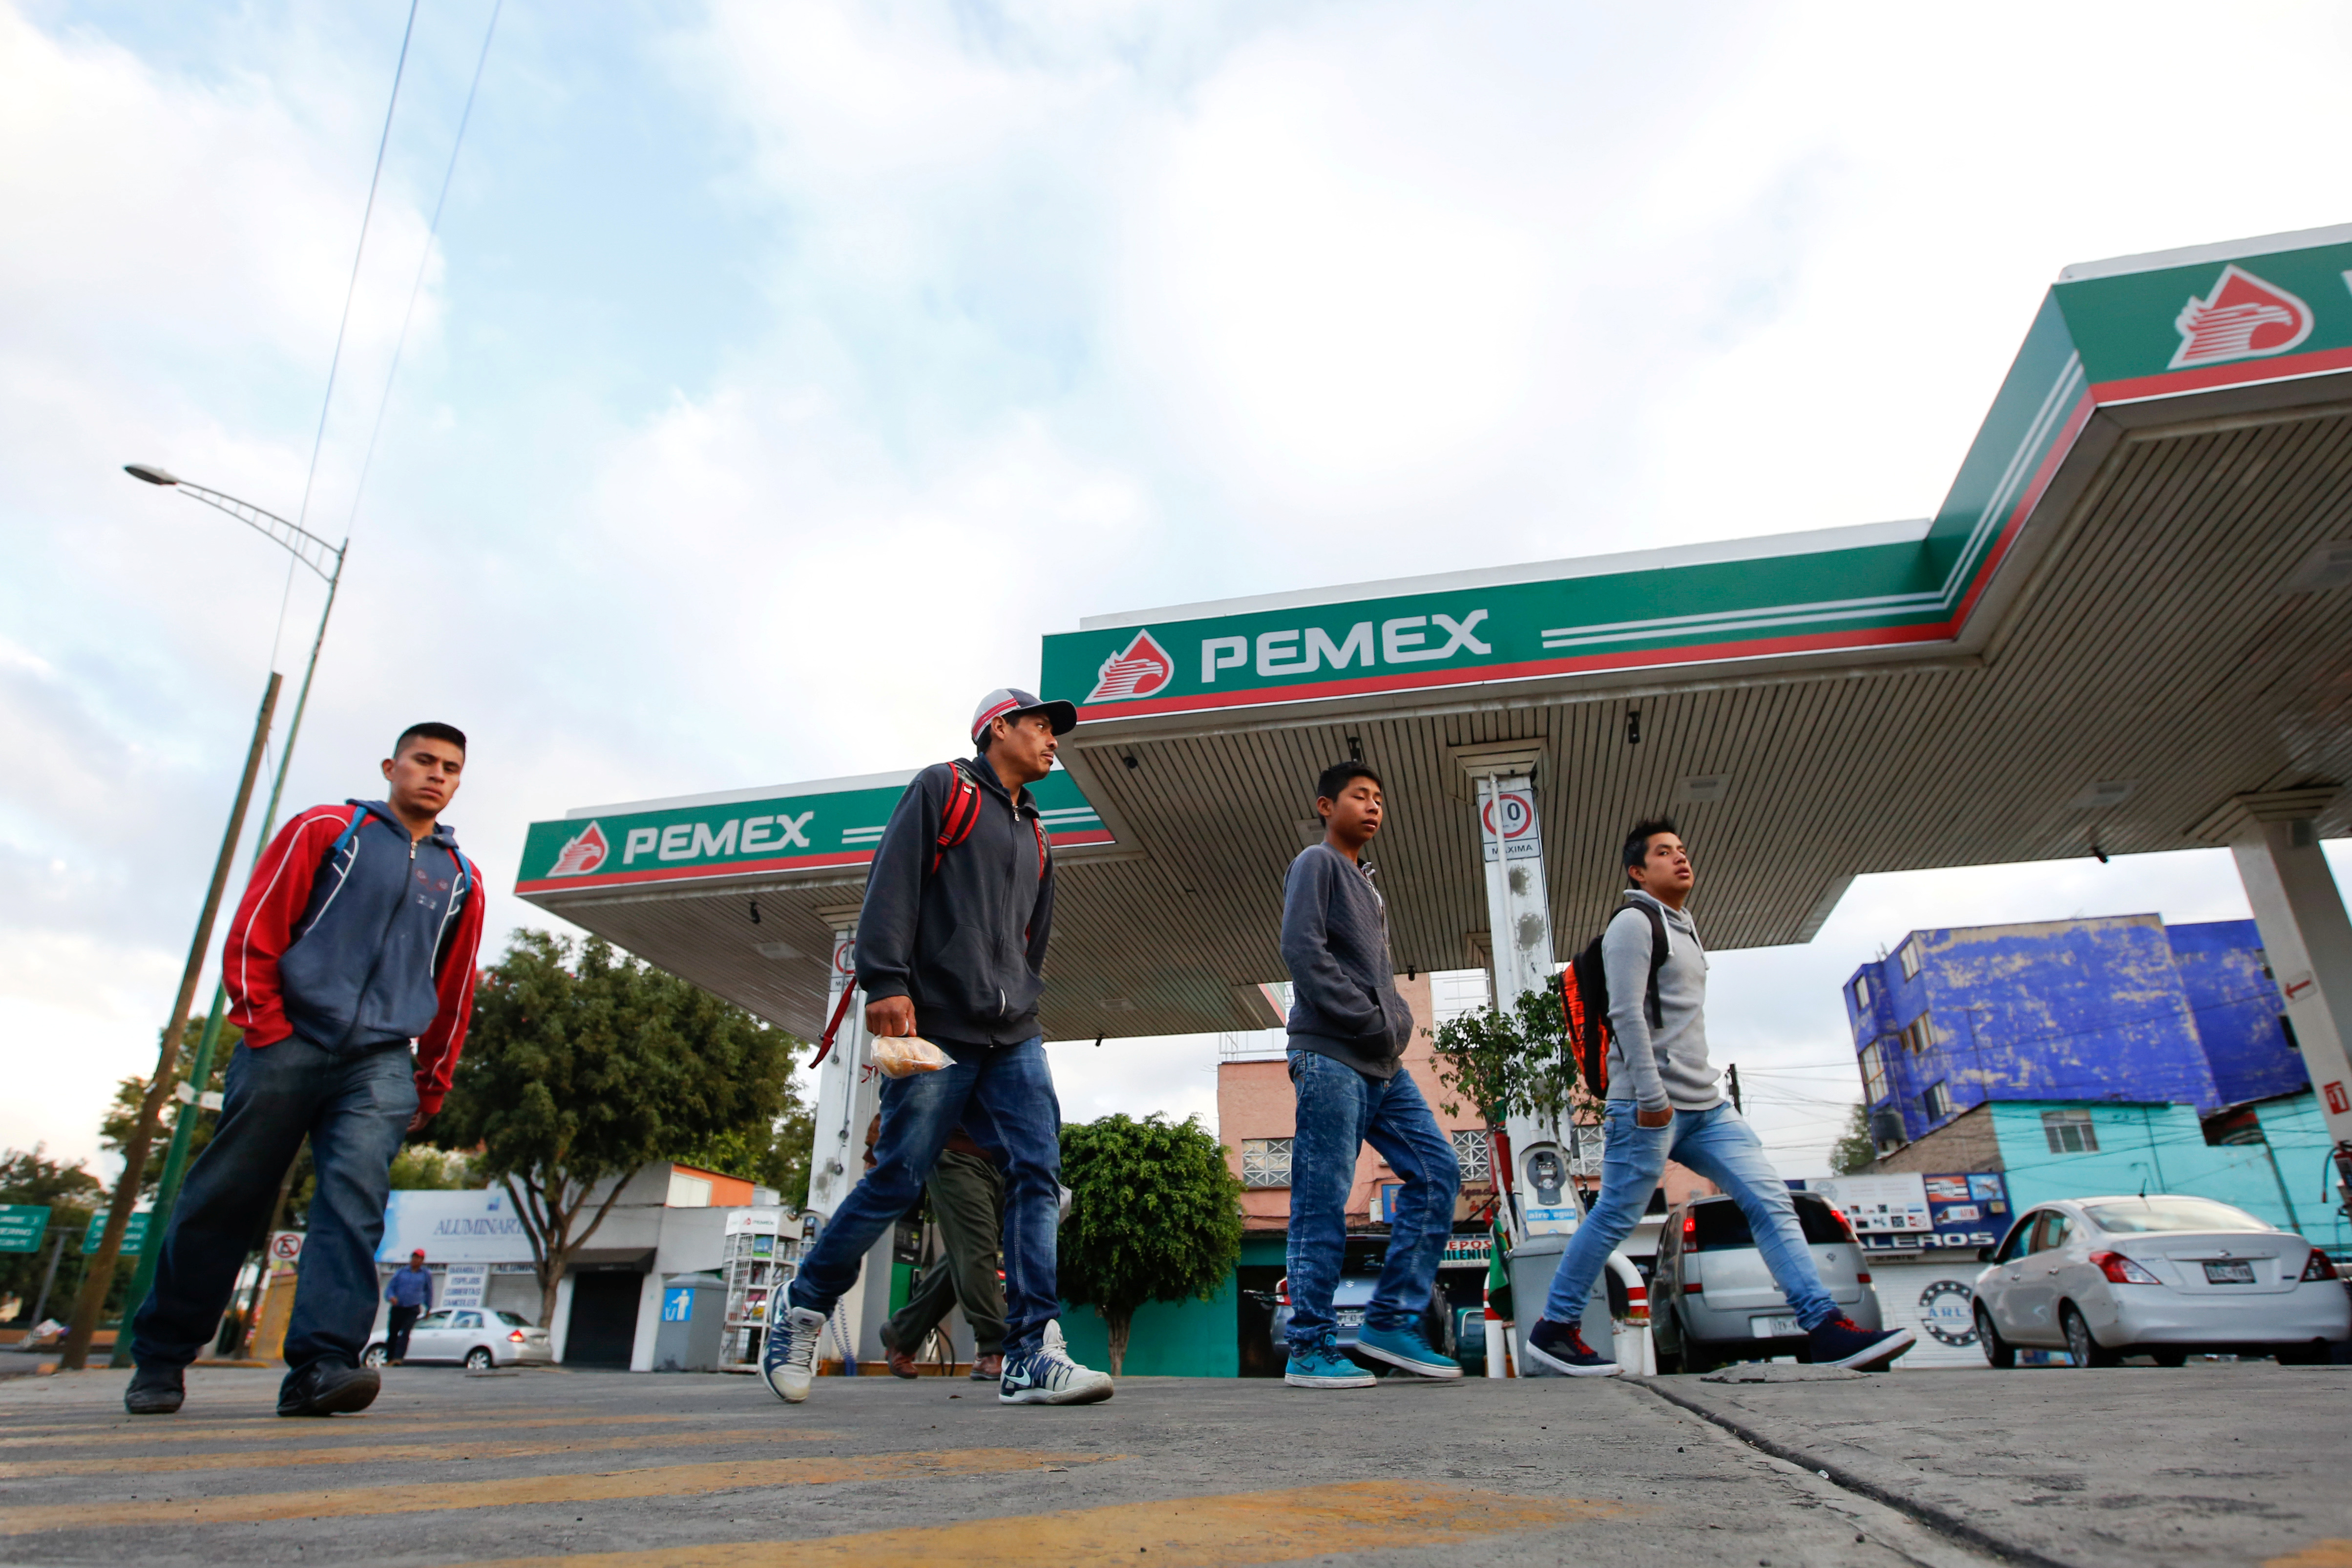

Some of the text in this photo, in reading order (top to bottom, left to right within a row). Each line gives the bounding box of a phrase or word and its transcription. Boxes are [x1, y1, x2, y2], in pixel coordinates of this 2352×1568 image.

[1200, 608, 1492, 684] PEMEX
[622, 811, 815, 864] PEMEX
[1554, 1211, 1575, 1219] agua
